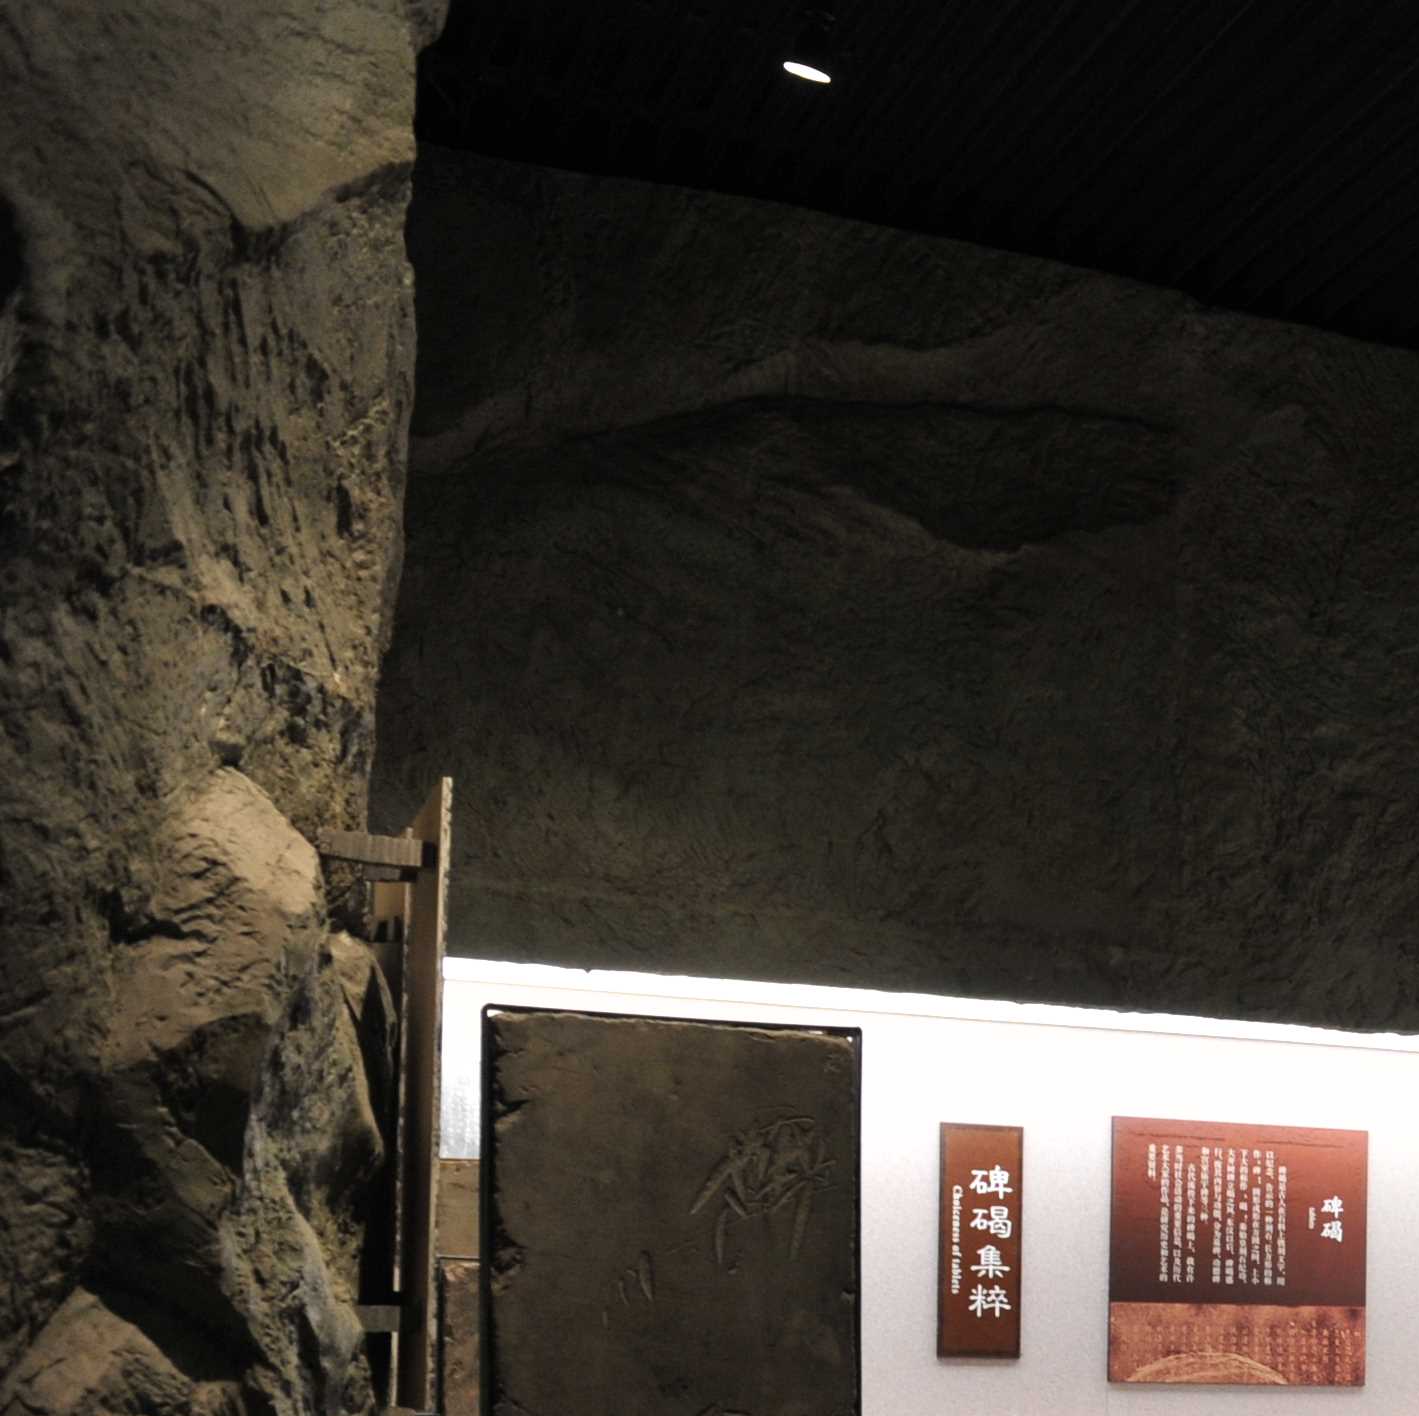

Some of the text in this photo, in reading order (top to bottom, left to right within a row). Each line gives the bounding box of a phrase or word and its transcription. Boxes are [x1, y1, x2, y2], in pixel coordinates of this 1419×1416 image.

[1320, 1194, 1344, 1243] 碑碣
[951, 1244, 962, 1259] of
[968, 1164, 1013, 1318] 碑碣集粹
[951, 1259, 963, 1295] tablets
